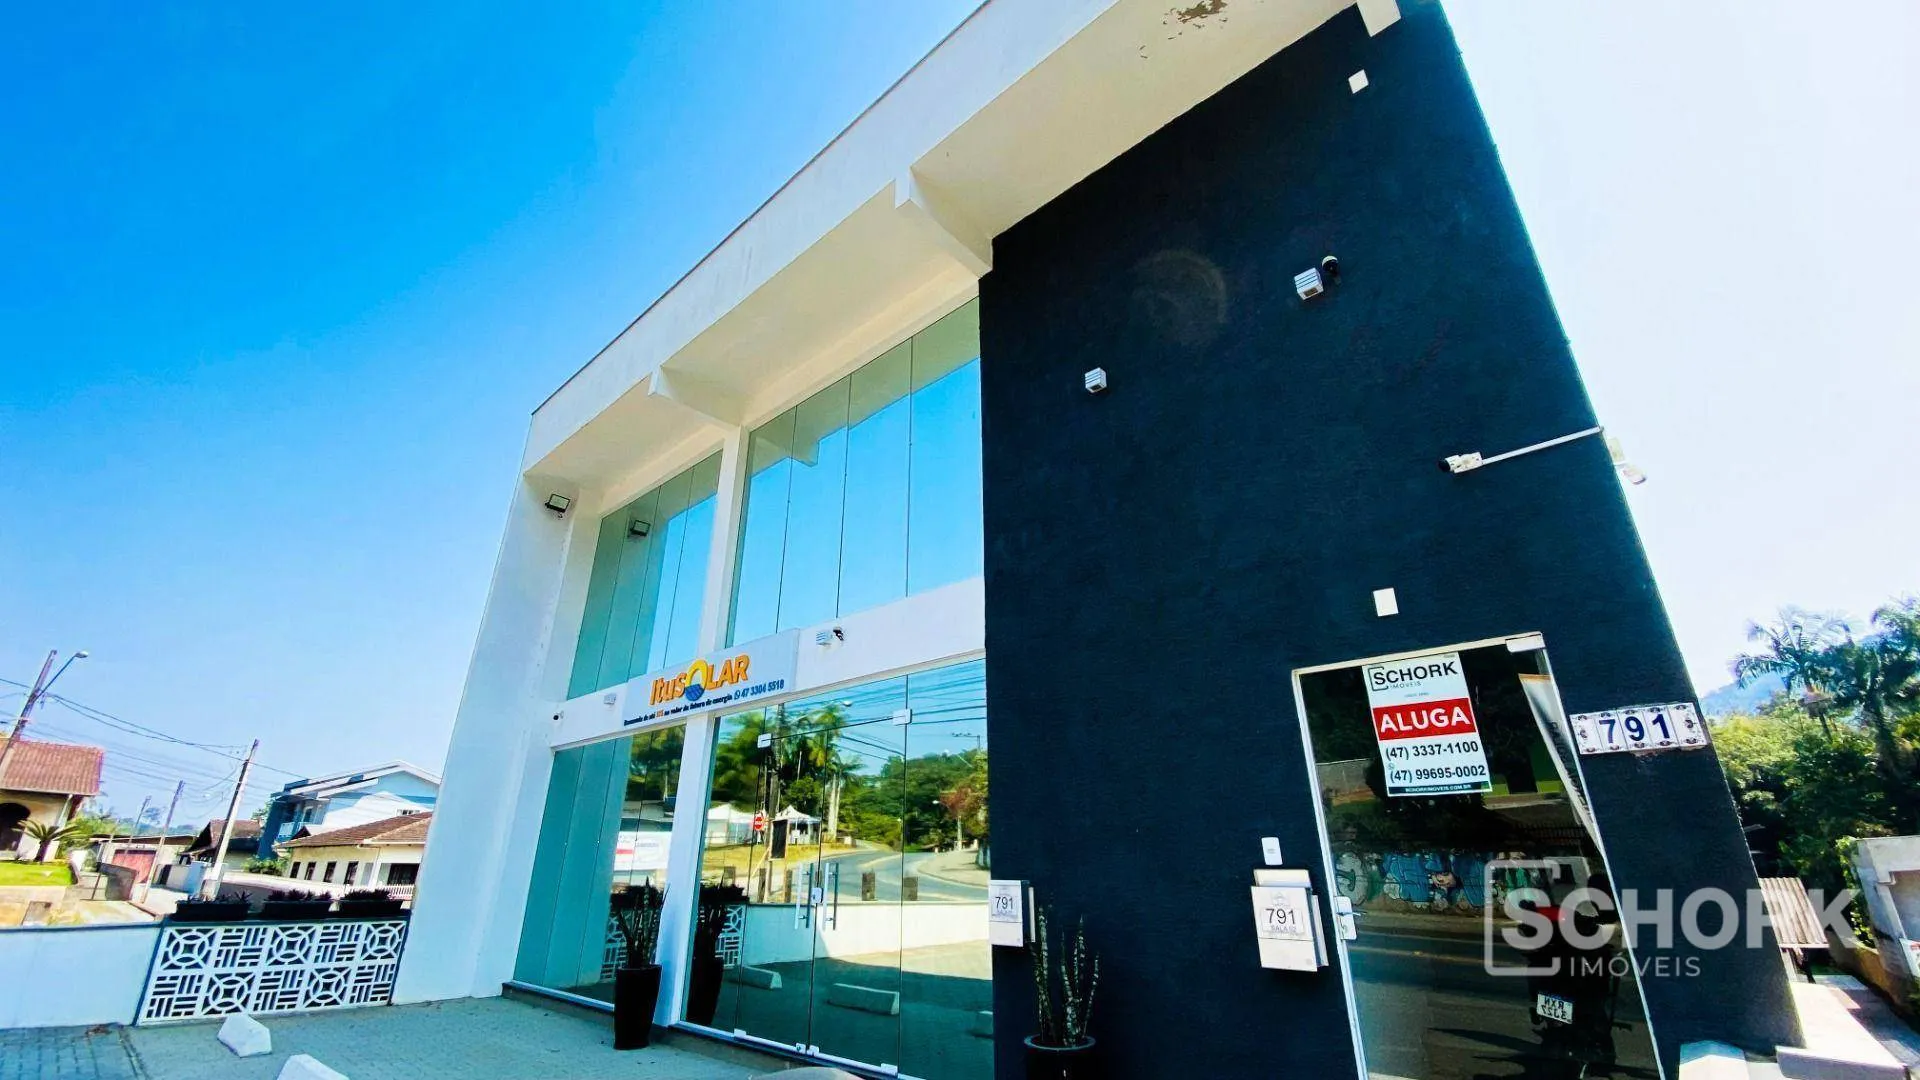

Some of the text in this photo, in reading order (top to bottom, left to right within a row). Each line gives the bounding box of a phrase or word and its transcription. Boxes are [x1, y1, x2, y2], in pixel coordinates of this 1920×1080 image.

[1373, 661, 1458, 685] SCHORK
[741, 687, 750, 697] 47
[1380, 706, 1470, 733] ALUGA
[1598, 713, 1670, 744] 791
[1385, 741, 1479, 761] (47) 3337-1100
[1390, 765, 1486, 783] (47) 99695-0002
[995, 896, 1014, 910] 791
[1265, 908, 1295, 925] 791
